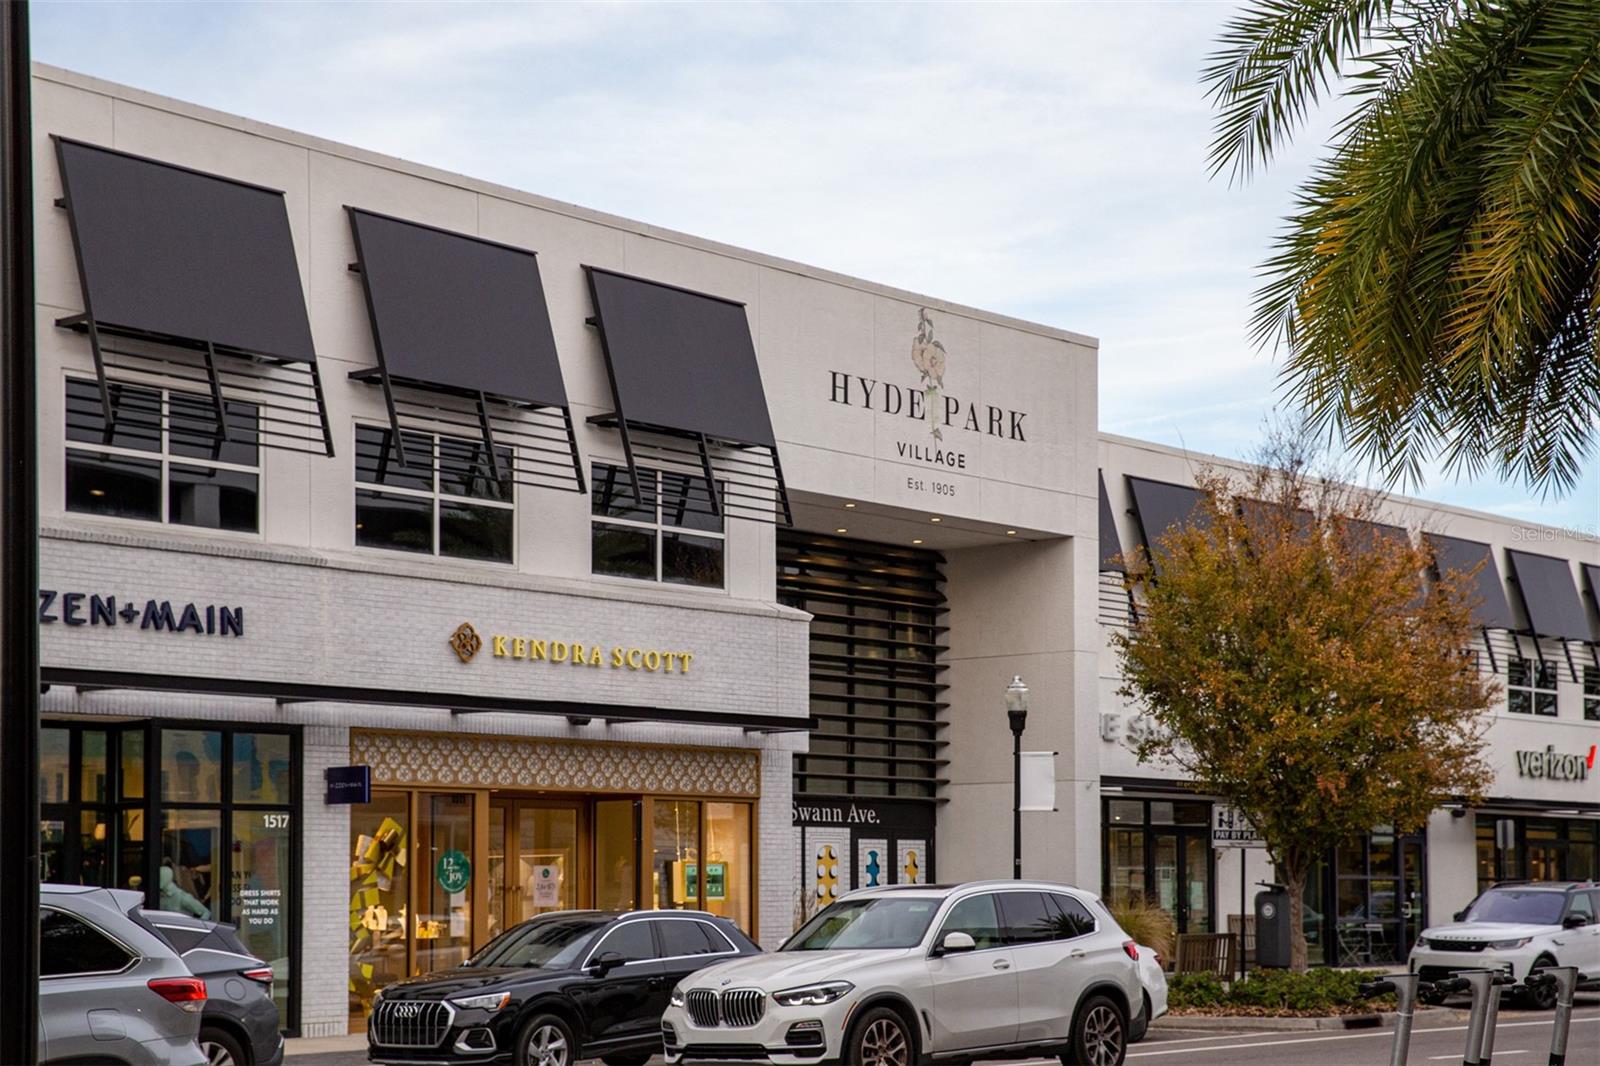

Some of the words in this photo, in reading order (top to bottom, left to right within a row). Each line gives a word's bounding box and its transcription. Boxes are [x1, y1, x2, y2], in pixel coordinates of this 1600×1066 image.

[828, 370, 925, 421] HYDE
[942, 395, 1027, 442] PARK
[897, 441, 966, 468] VILLAGE
[907, 477, 927, 492] Est.
[932, 482, 955, 496] 1905
[492, 635, 603, 666] KENDRA
[612, 646, 693, 673] SCOTT
[1516, 745, 1588, 781] verizon
[263, 814, 290, 829] 1517
[847, 804, 880, 824] Ave.
[1215, 831, 1229, 839] PAY
[1231, 831, 1241, 839] BY
[443, 857, 454, 870] 12
[260, 889, 281, 897] SHIRTS
